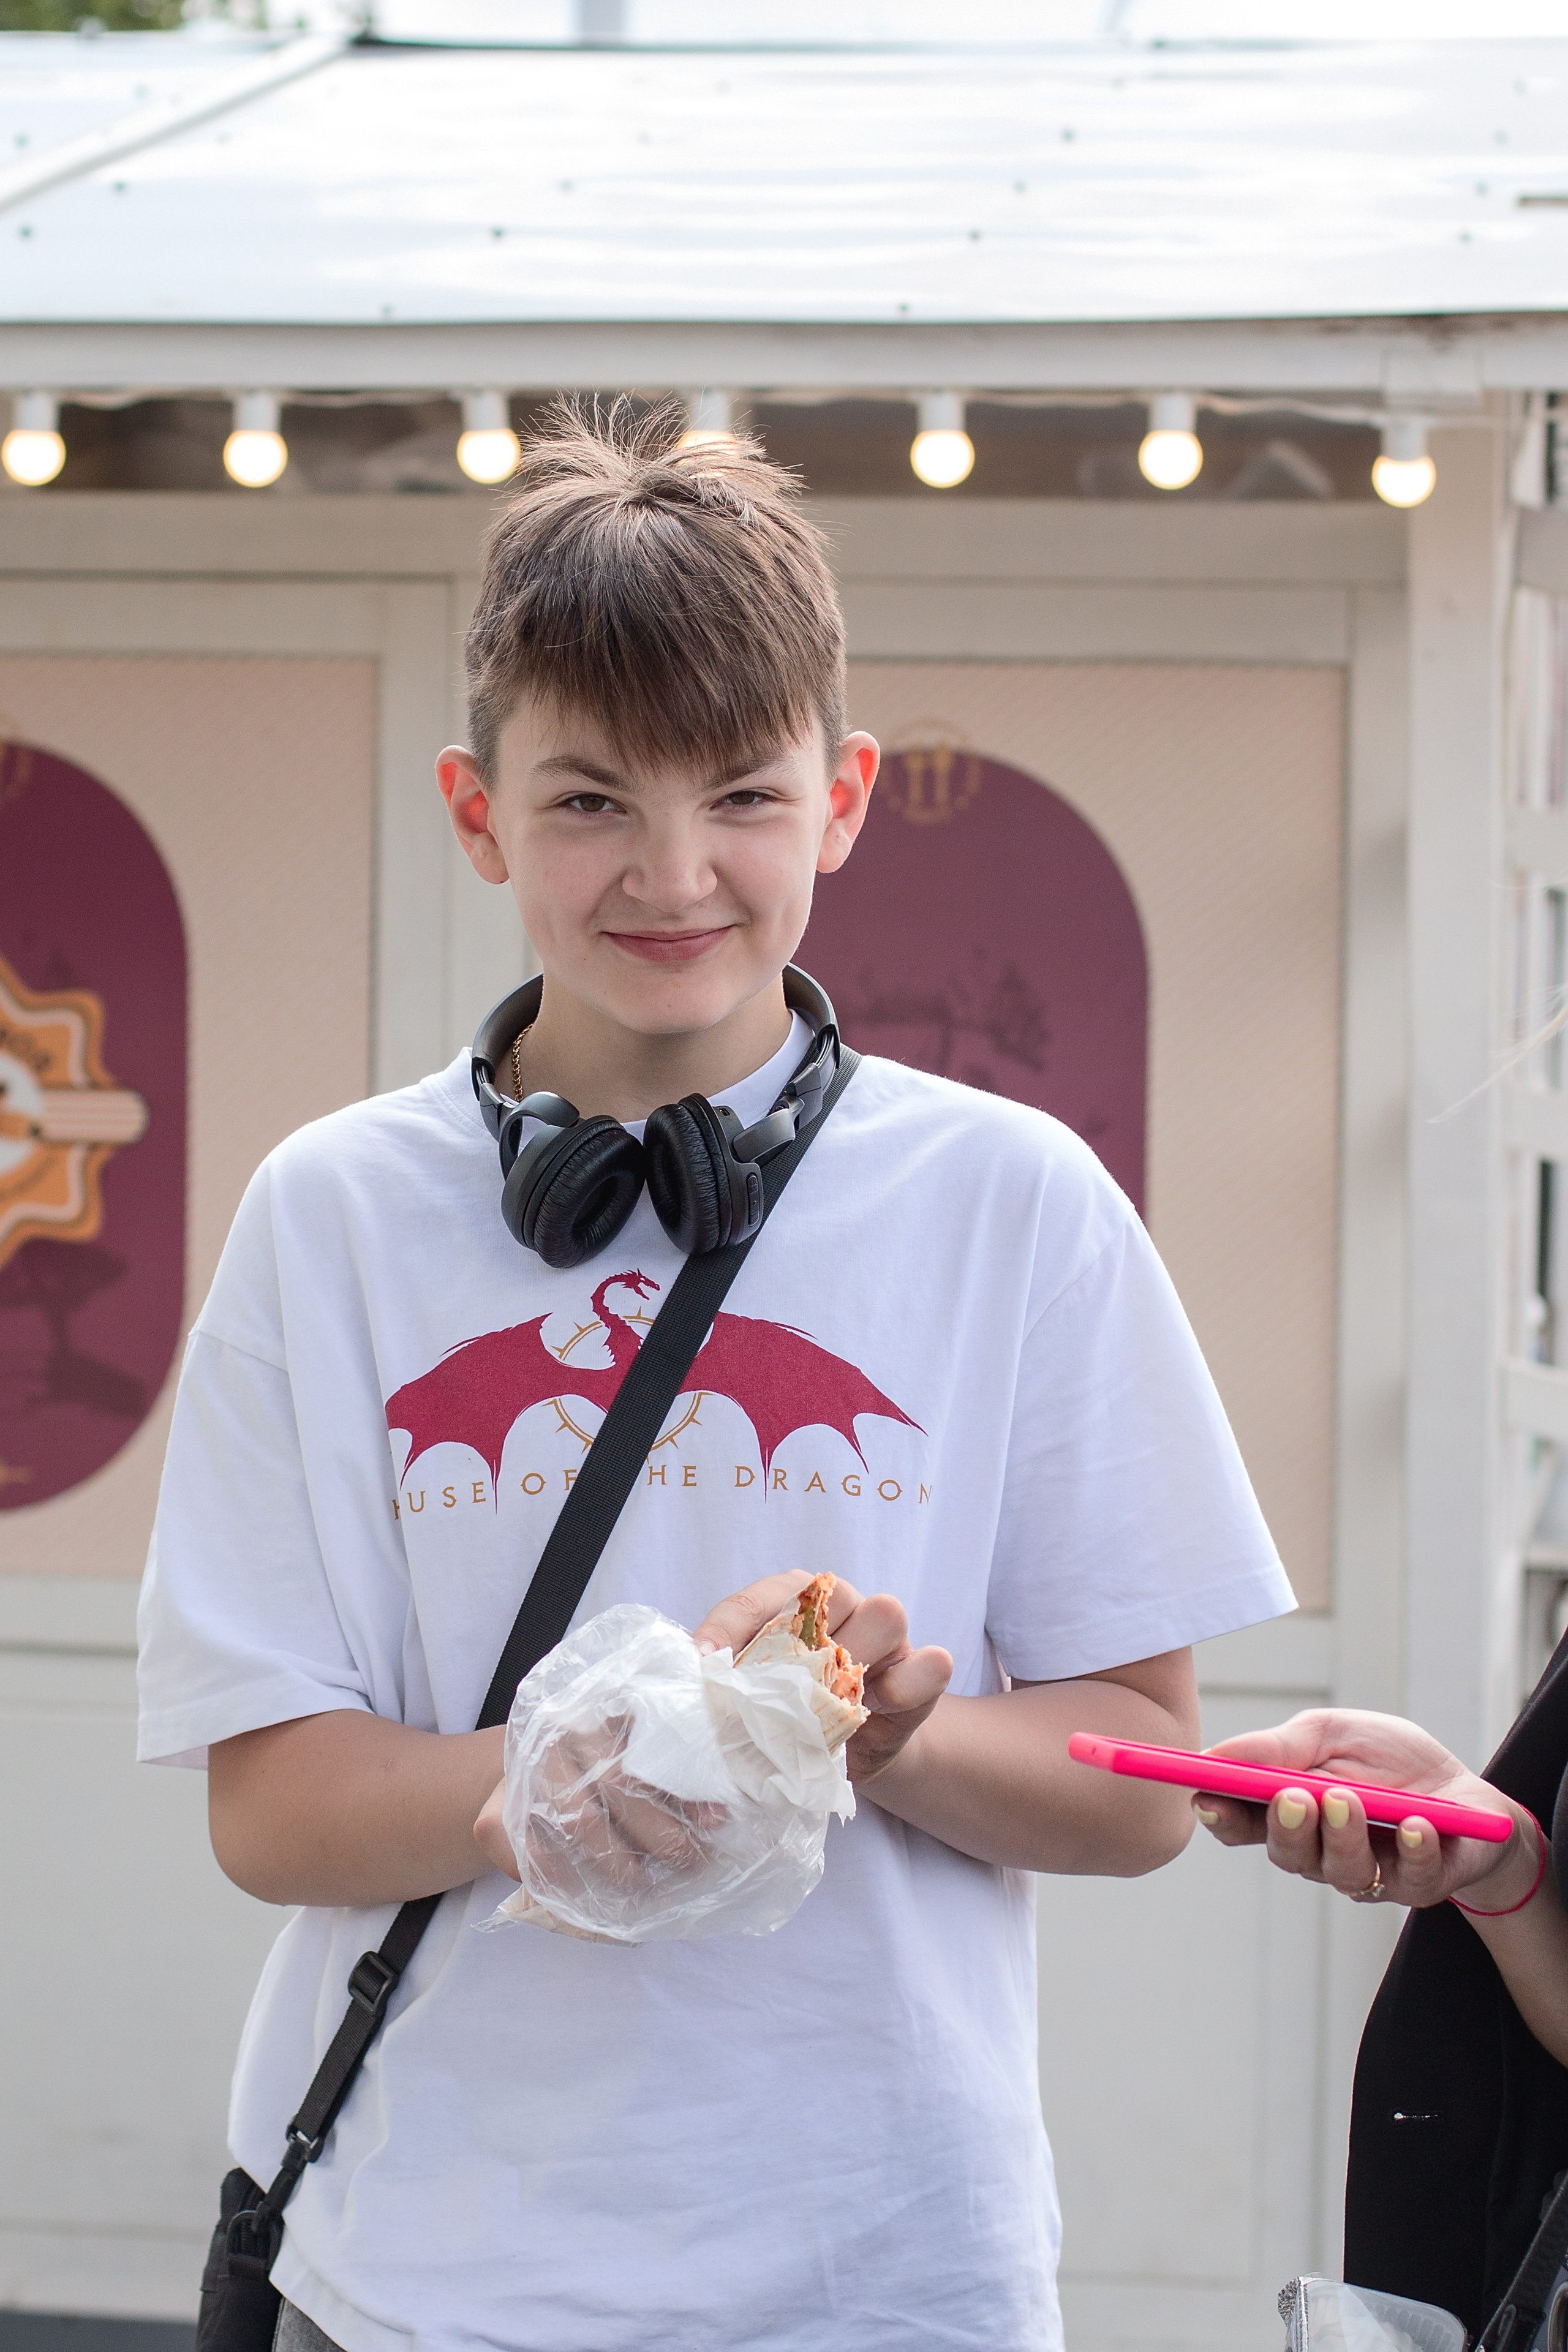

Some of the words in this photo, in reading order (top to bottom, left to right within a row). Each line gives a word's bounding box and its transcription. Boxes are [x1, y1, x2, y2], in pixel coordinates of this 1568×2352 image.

[392, 1481, 486, 1520] USE
[521, 1469, 578, 1495] OF
[647, 1464, 697, 1487] HE
[734, 1465, 933, 1506] DRAGON
